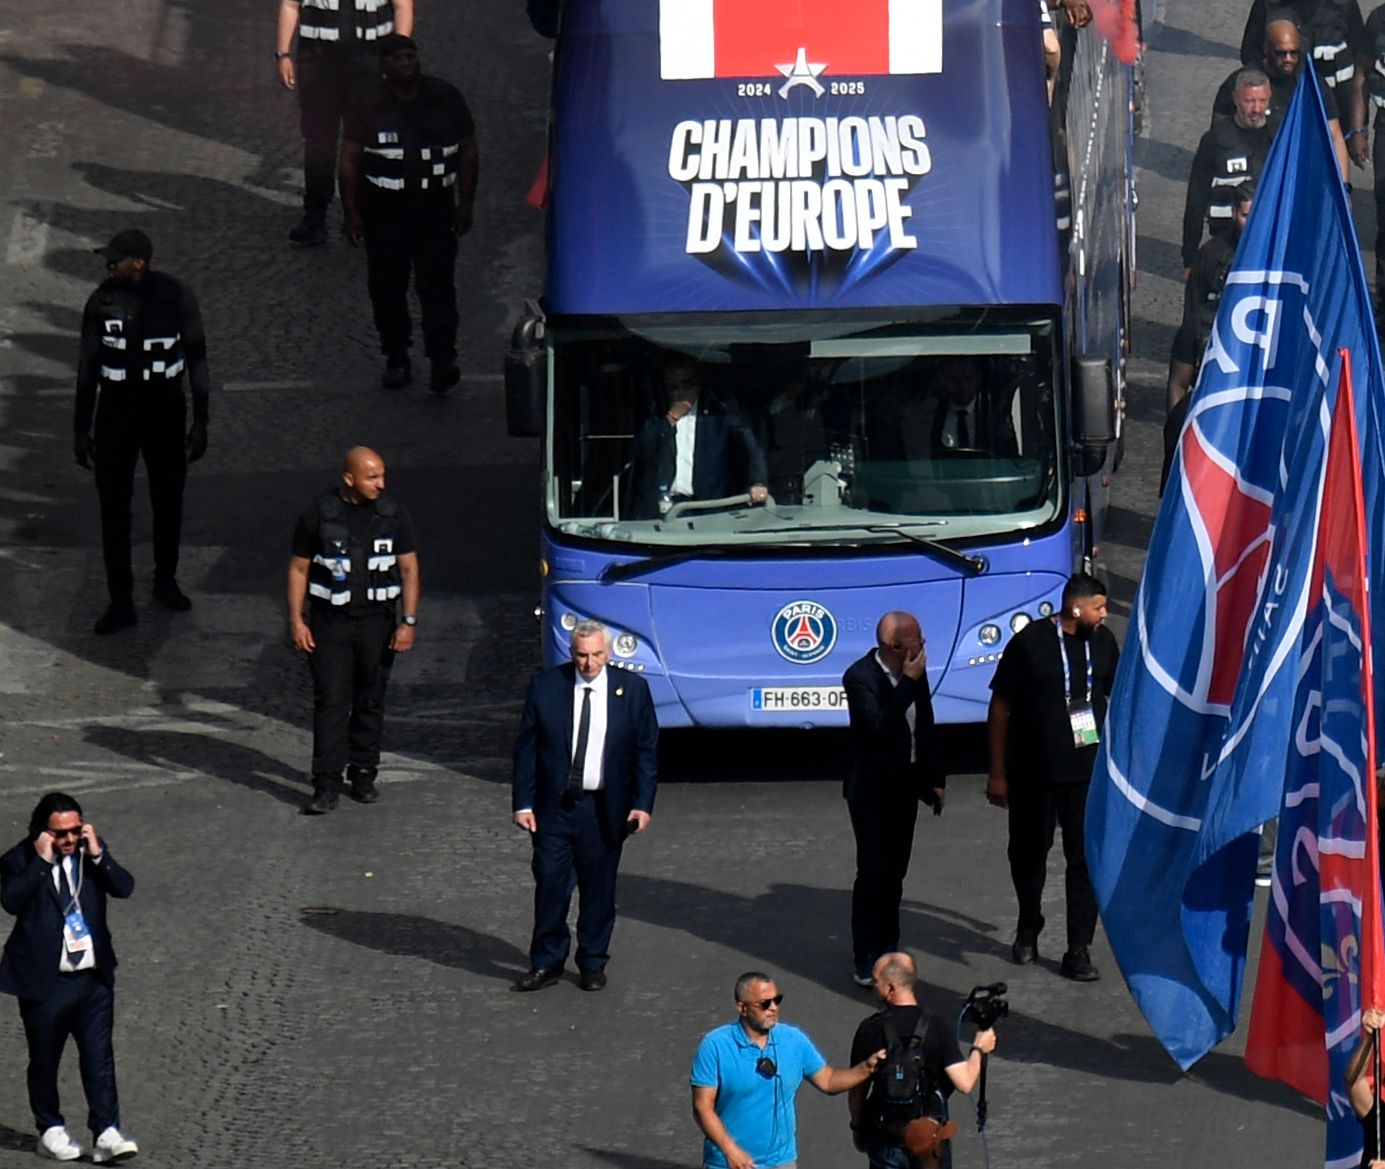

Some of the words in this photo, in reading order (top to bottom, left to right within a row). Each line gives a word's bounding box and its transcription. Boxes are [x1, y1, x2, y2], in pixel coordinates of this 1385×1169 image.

[737, 83, 771, 96] 2024
[830, 82, 865, 96] 2025
[668, 114, 932, 182] CHAMPIONS
[686, 177, 918, 255] D'EUROPE
[782, 601, 825, 621] PARIS
